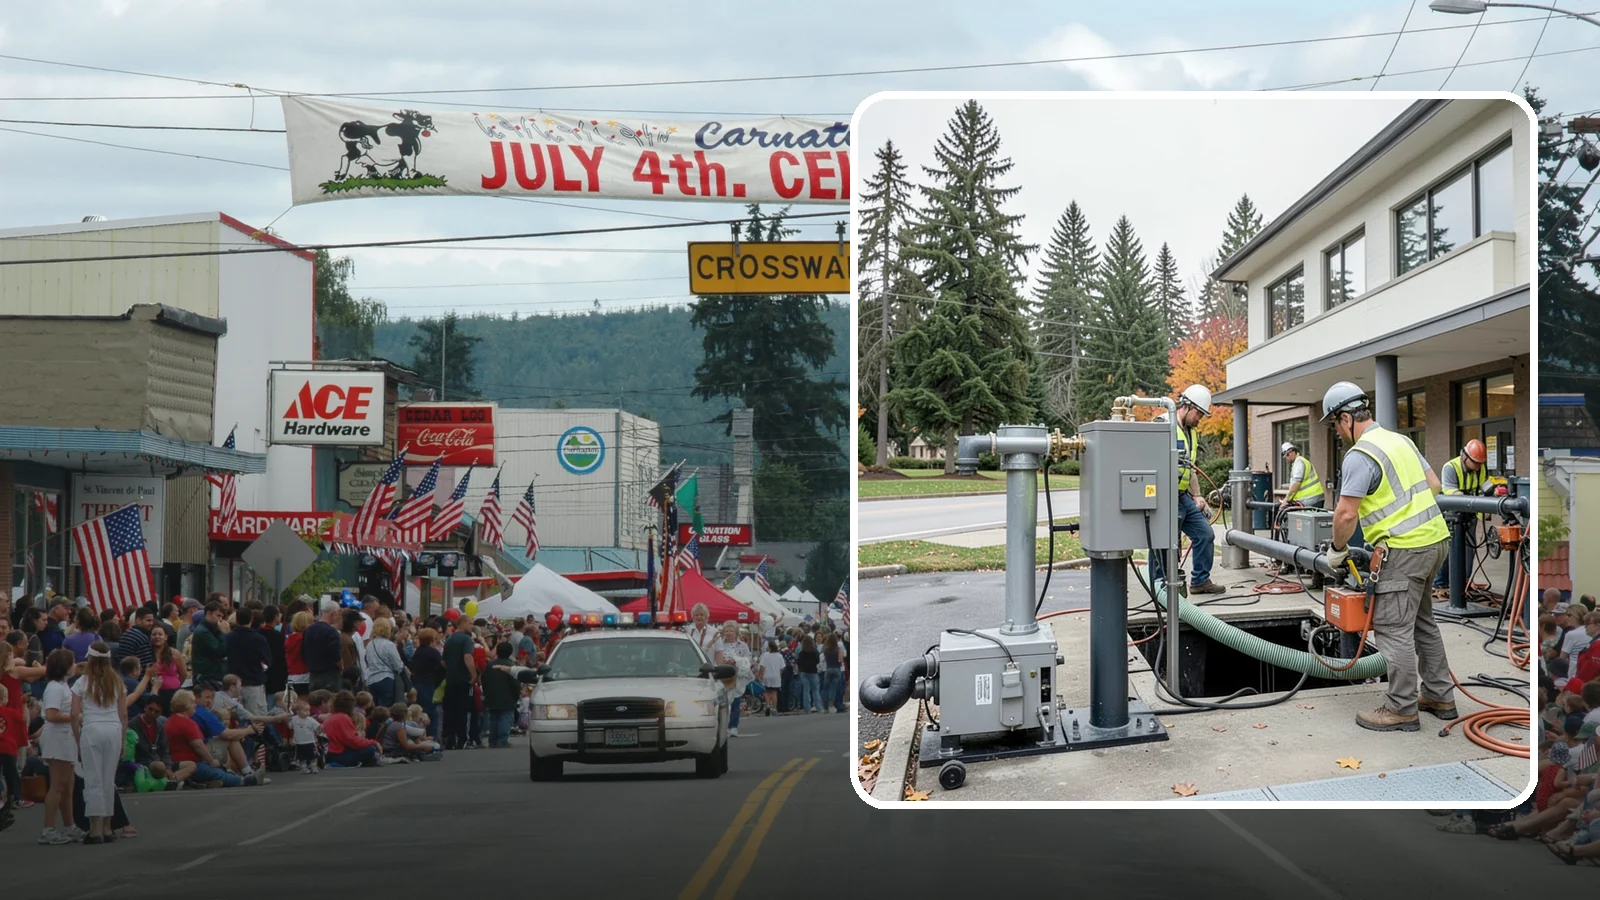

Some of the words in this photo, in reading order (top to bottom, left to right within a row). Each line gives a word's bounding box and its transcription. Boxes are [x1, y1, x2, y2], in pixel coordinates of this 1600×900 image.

[481, 141, 604, 193] JULY
[632, 150, 746, 197] 4th.
[697, 254, 850, 280] CROSSWA
[283, 380, 373, 420] ACE
[405, 409, 452, 422] CEDAR
[283, 421, 370, 436] Hardware
[416, 428, 477, 447] Coca-Cola
[354, 466, 385, 479] Simpl
[95, 485, 124, 494] Vincent
[126, 486, 136, 494] de
[137, 486, 155, 495] Paul
[688, 526, 741, 535] CRNATION
[699, 535, 730, 543] GLASS
